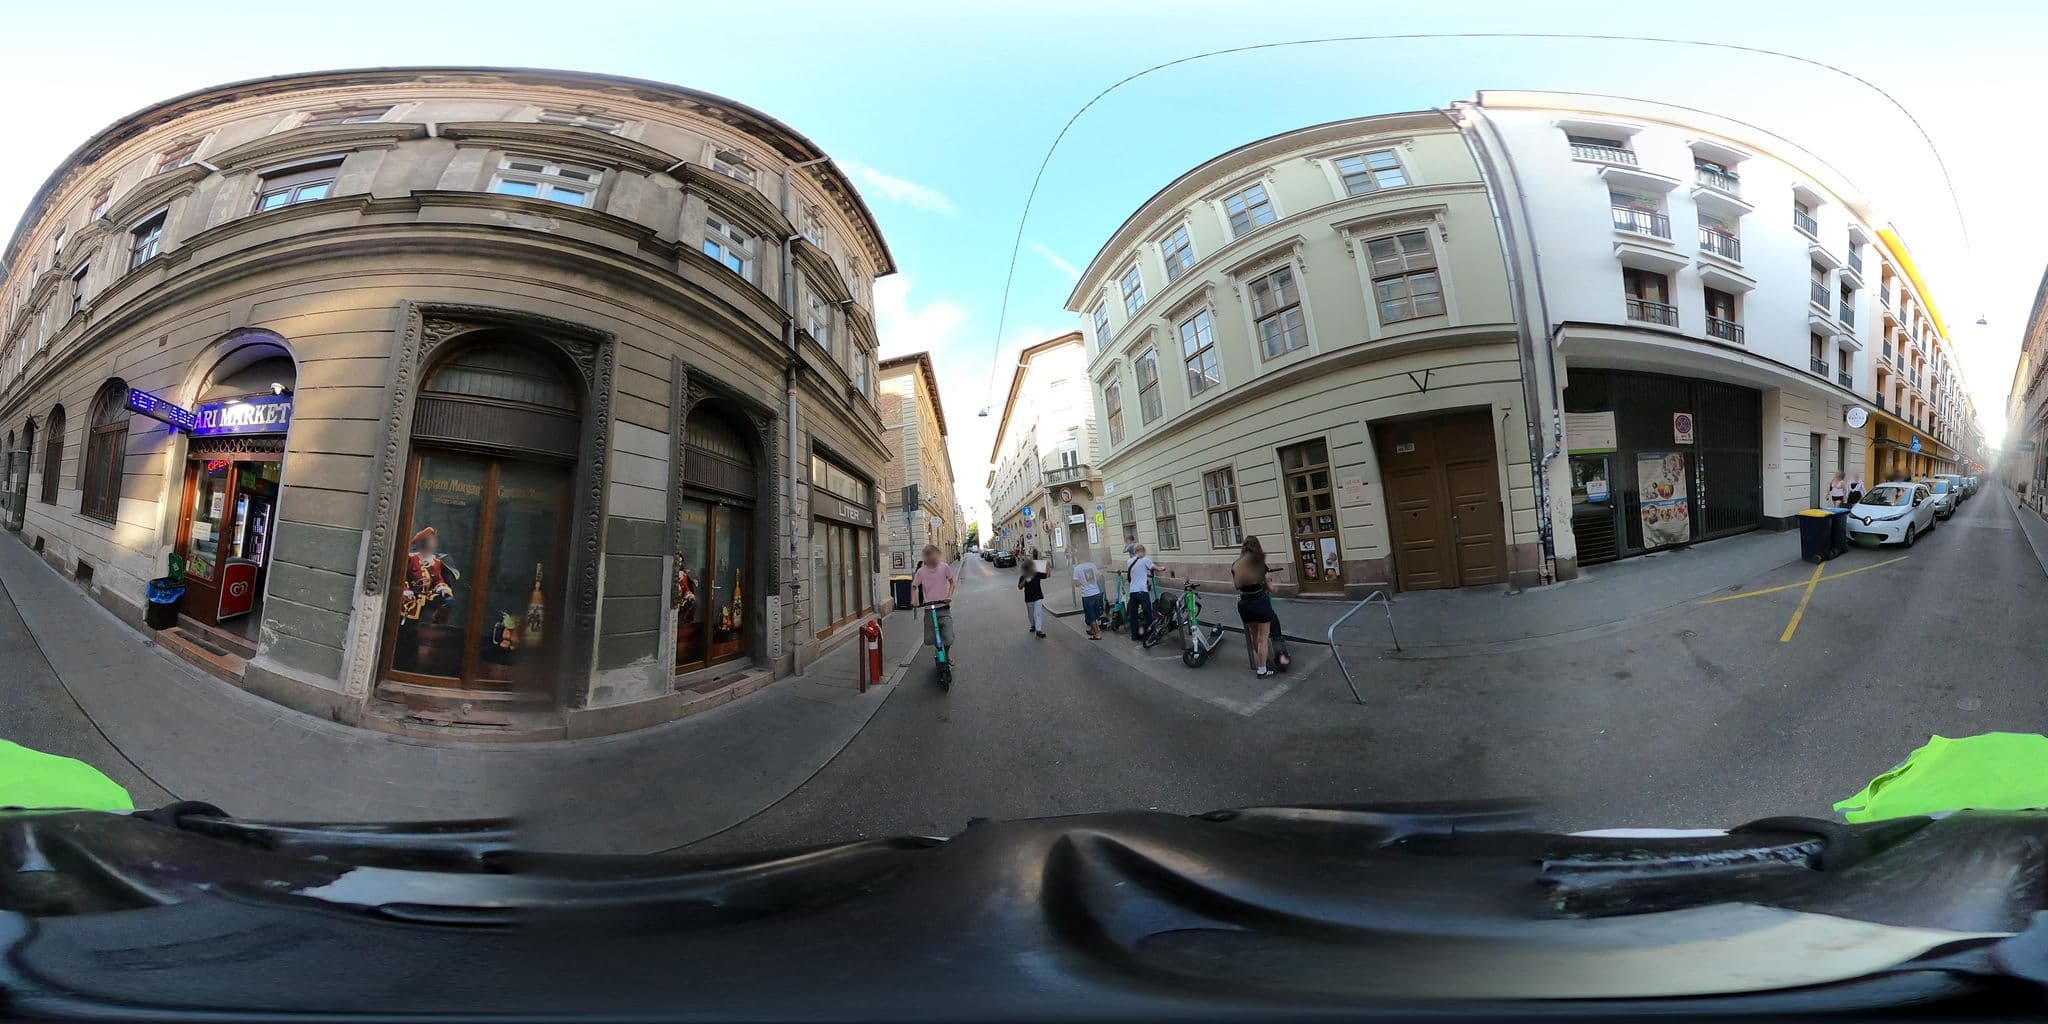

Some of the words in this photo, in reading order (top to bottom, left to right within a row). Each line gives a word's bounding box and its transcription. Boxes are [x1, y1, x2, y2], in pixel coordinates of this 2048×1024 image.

[220, 402, 291, 428] MARKET
[207, 459, 230, 471] OPEN
[448, 479, 481, 497] Morgan
